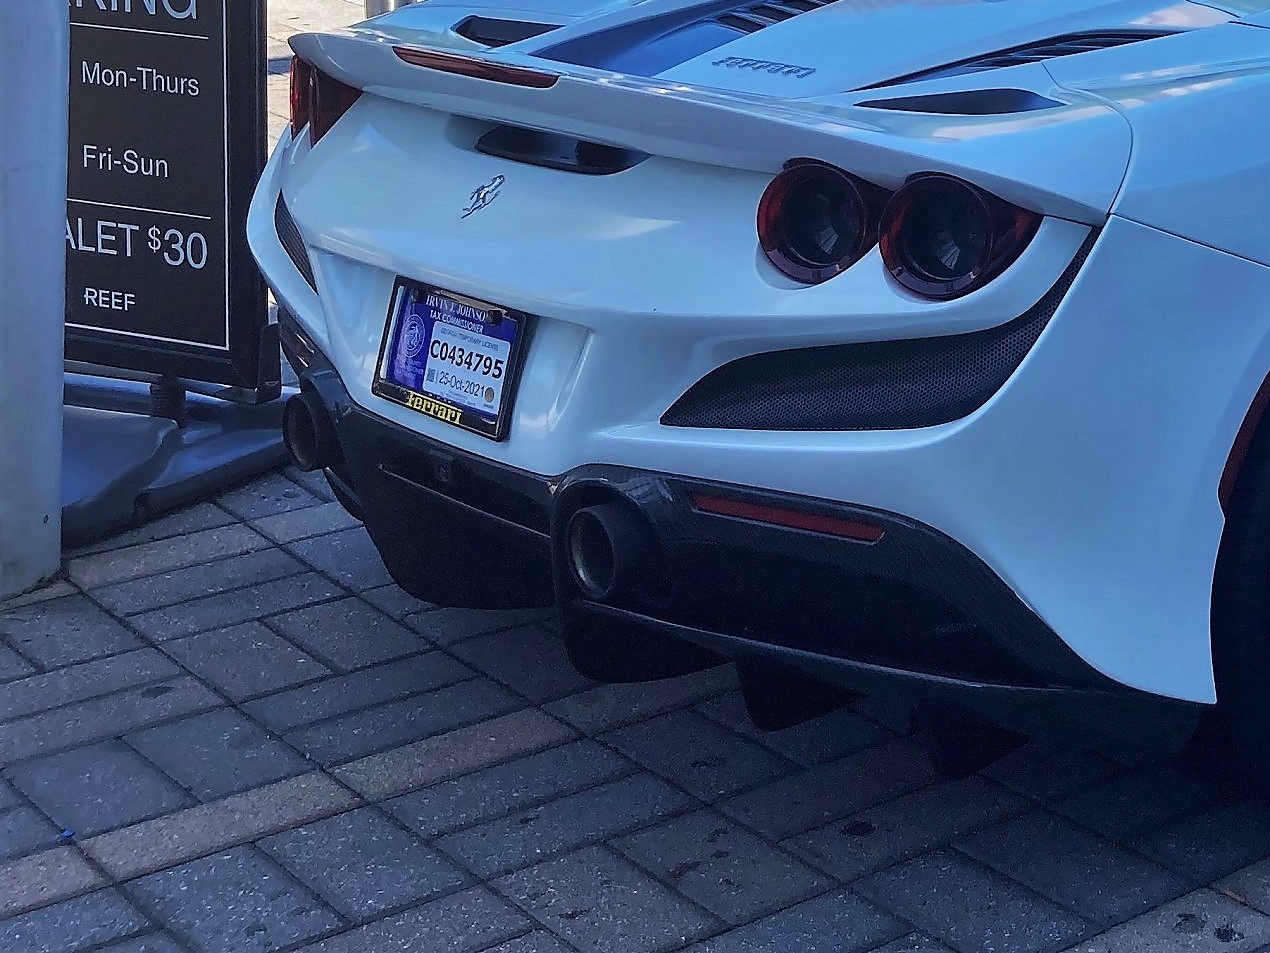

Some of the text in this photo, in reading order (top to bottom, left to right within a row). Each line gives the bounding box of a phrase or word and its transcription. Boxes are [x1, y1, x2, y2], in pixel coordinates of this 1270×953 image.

[81, 60, 200, 97] Mon-Thurs
[83, 144, 169, 178] Fri-Sun
[147, 225, 208, 269] $30
[84, 287, 136, 311] REEF
[455, 303, 489, 324] JOHNSO
[430, 309, 441, 321] TAX
[430, 339, 504, 379] C0434795
[438, 370, 485, 398] 25-Oct-2021
